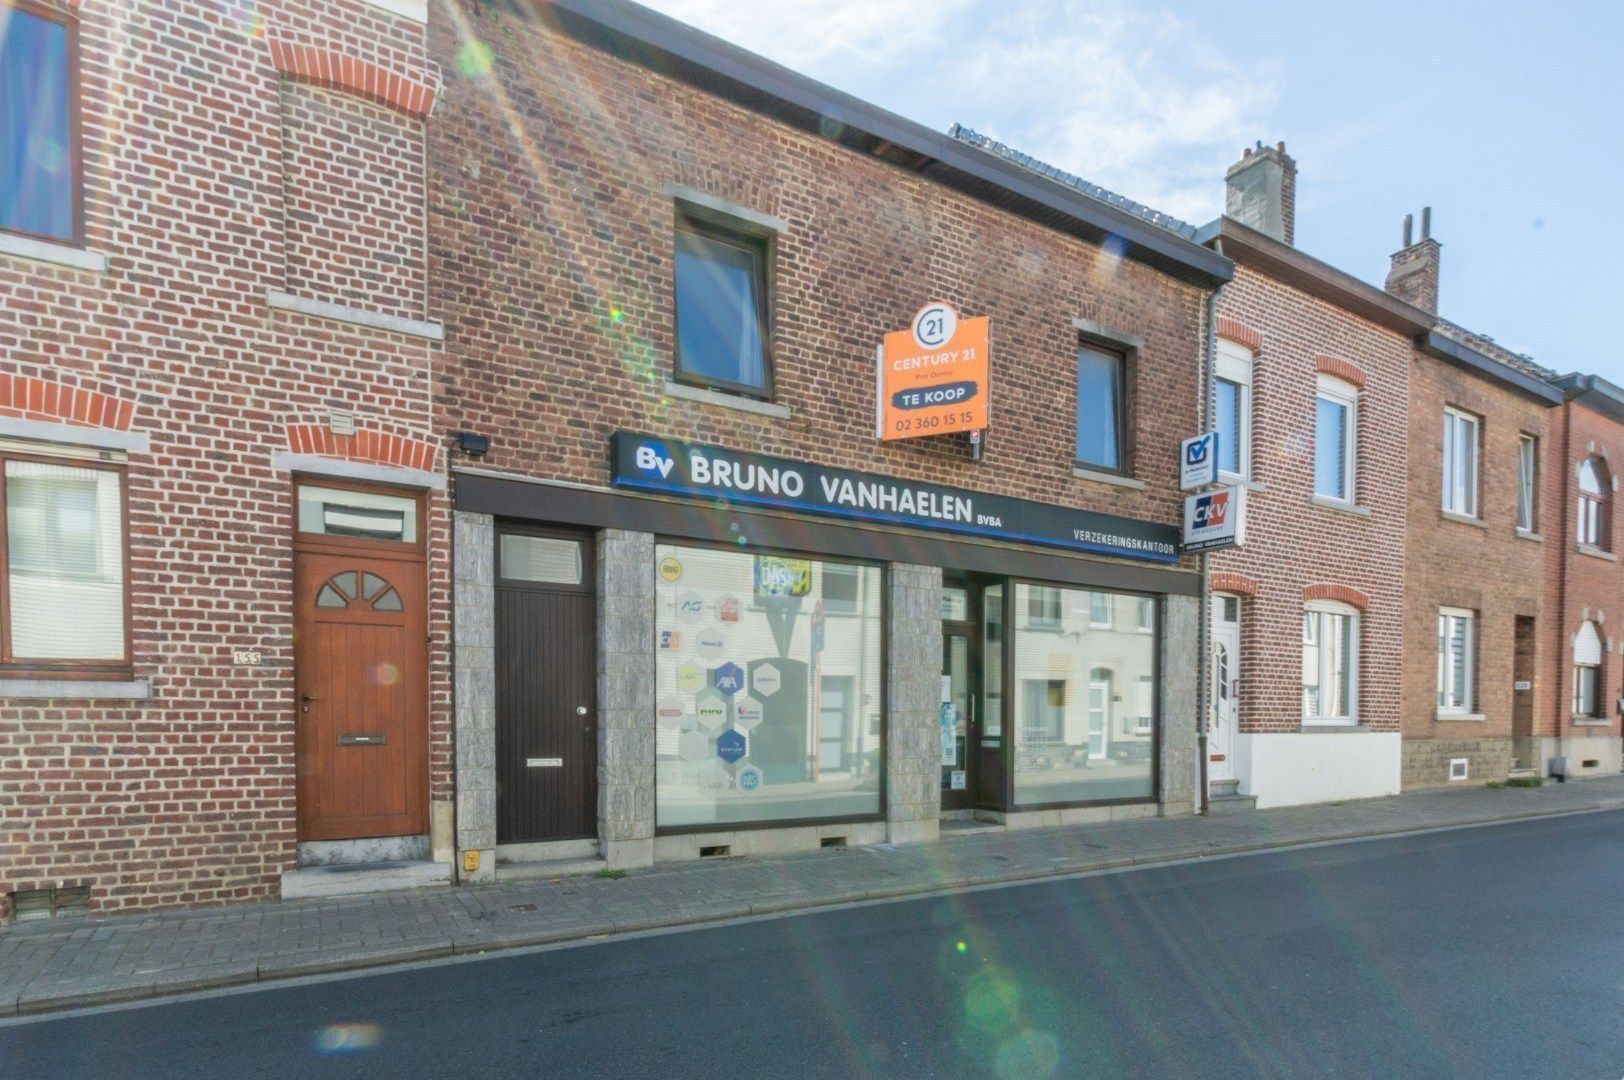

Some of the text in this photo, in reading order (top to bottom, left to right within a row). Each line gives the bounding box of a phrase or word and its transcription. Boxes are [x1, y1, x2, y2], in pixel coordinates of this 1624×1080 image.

[926, 318, 943, 336] 21
[893, 348, 976, 371] CENTURY 21
[902, 387, 965, 405] TE KOOP
[895, 411, 972, 431] 02 360 15 15
[691, 455, 1001, 528] BRUNO VANHAELEN BVBA
[1193, 502, 1227, 522] CKV
[1073, 529, 1174, 554] VERZEKERINGSKANTOOR
[235, 652, 260, 664] 155
[716, 676, 738, 688] AXA
